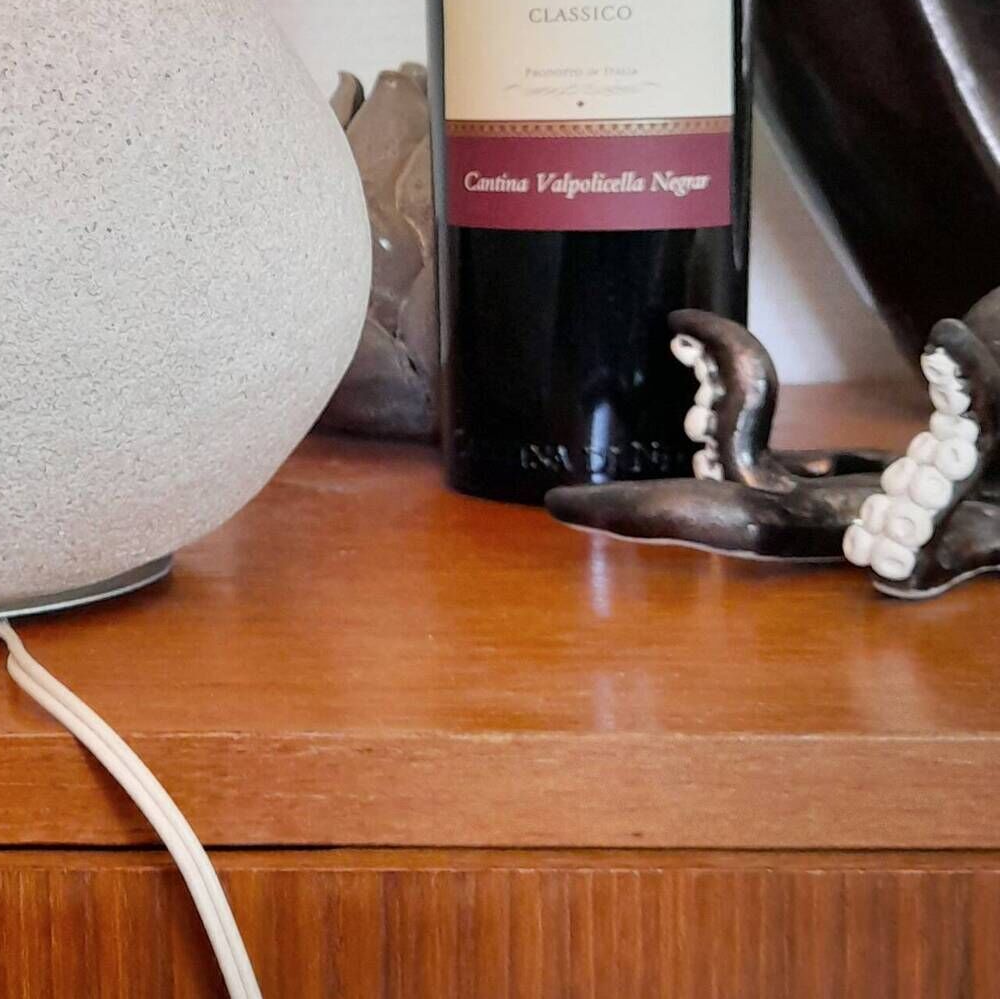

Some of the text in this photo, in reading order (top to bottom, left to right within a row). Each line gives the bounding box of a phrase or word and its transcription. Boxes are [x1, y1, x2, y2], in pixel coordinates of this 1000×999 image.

[528, 5, 634, 23] CLASSICO
[464, 171, 529, 193] Cantina
[536, 172, 645, 199] Valpolicella
